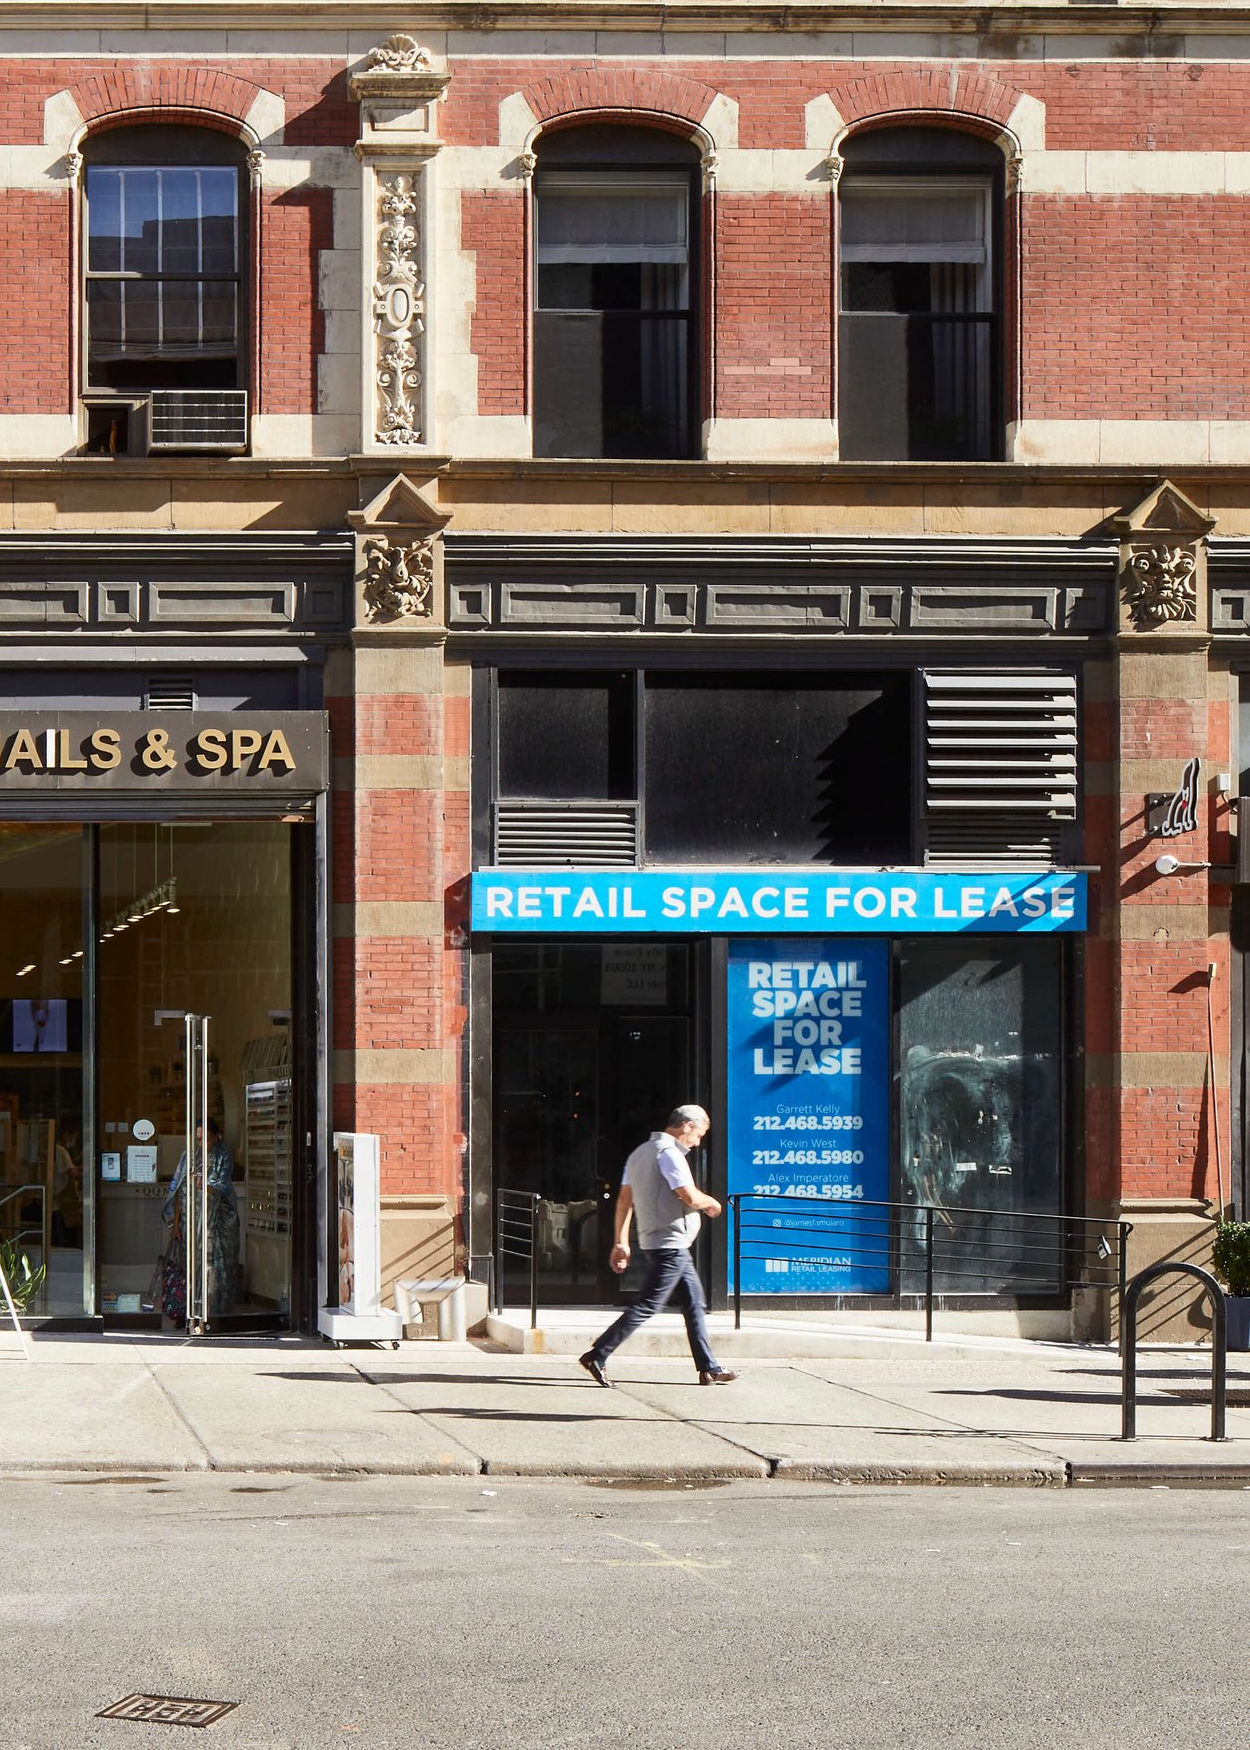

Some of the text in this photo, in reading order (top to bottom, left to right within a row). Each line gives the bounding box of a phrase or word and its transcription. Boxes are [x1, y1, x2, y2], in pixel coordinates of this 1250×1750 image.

[142, 728, 178, 769] &
[196, 728, 297, 769] SPA
[487, 886, 1076, 919] RETAIL SPACE FOR LEASE
[748, 961, 867, 988] RETAIL
[752, 990, 862, 1017] SPACE
[773, 1019, 842, 1046] FOR
[754, 1048, 862, 1075] LEASE
[776, 1104, 840, 1116] Garrett Kelly
[753, 1116, 863, 1131] 212.468.5939
[780, 1139, 837, 1149] Kevin West
[752, 1150, 864, 1165] 212.468.5980
[768, 1174, 849, 1185] Alex Imperatore
[753, 1184, 864, 1200] 212.468.5954
[791, 1265, 852, 1273] RETAIL LEASING
